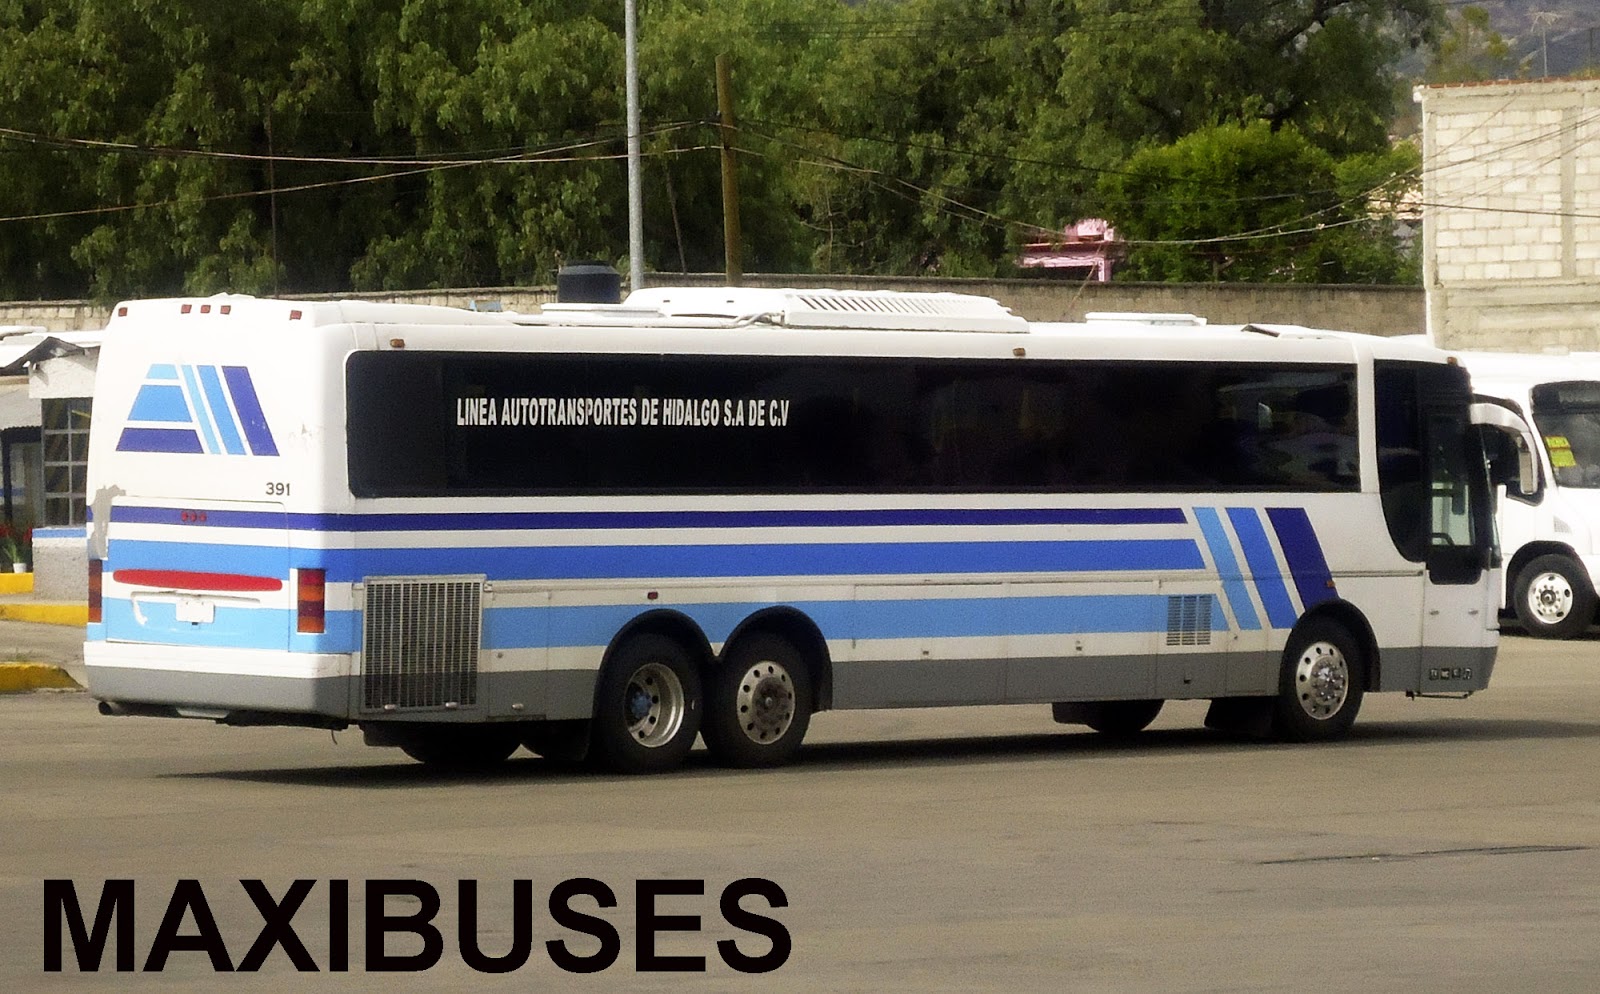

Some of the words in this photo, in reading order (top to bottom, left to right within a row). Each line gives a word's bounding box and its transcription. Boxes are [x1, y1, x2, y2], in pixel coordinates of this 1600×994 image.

[456, 397, 498, 426] LINEA
[500, 397, 637, 426] AUTOTRANSPORTES
[641, 398, 659, 426] DE
[662, 398, 720, 427] HIDALGO
[723, 398, 745, 427] S.A
[748, 399, 766, 427] DE
[769, 399, 790, 427] C.V
[265, 481, 291, 496] 391
